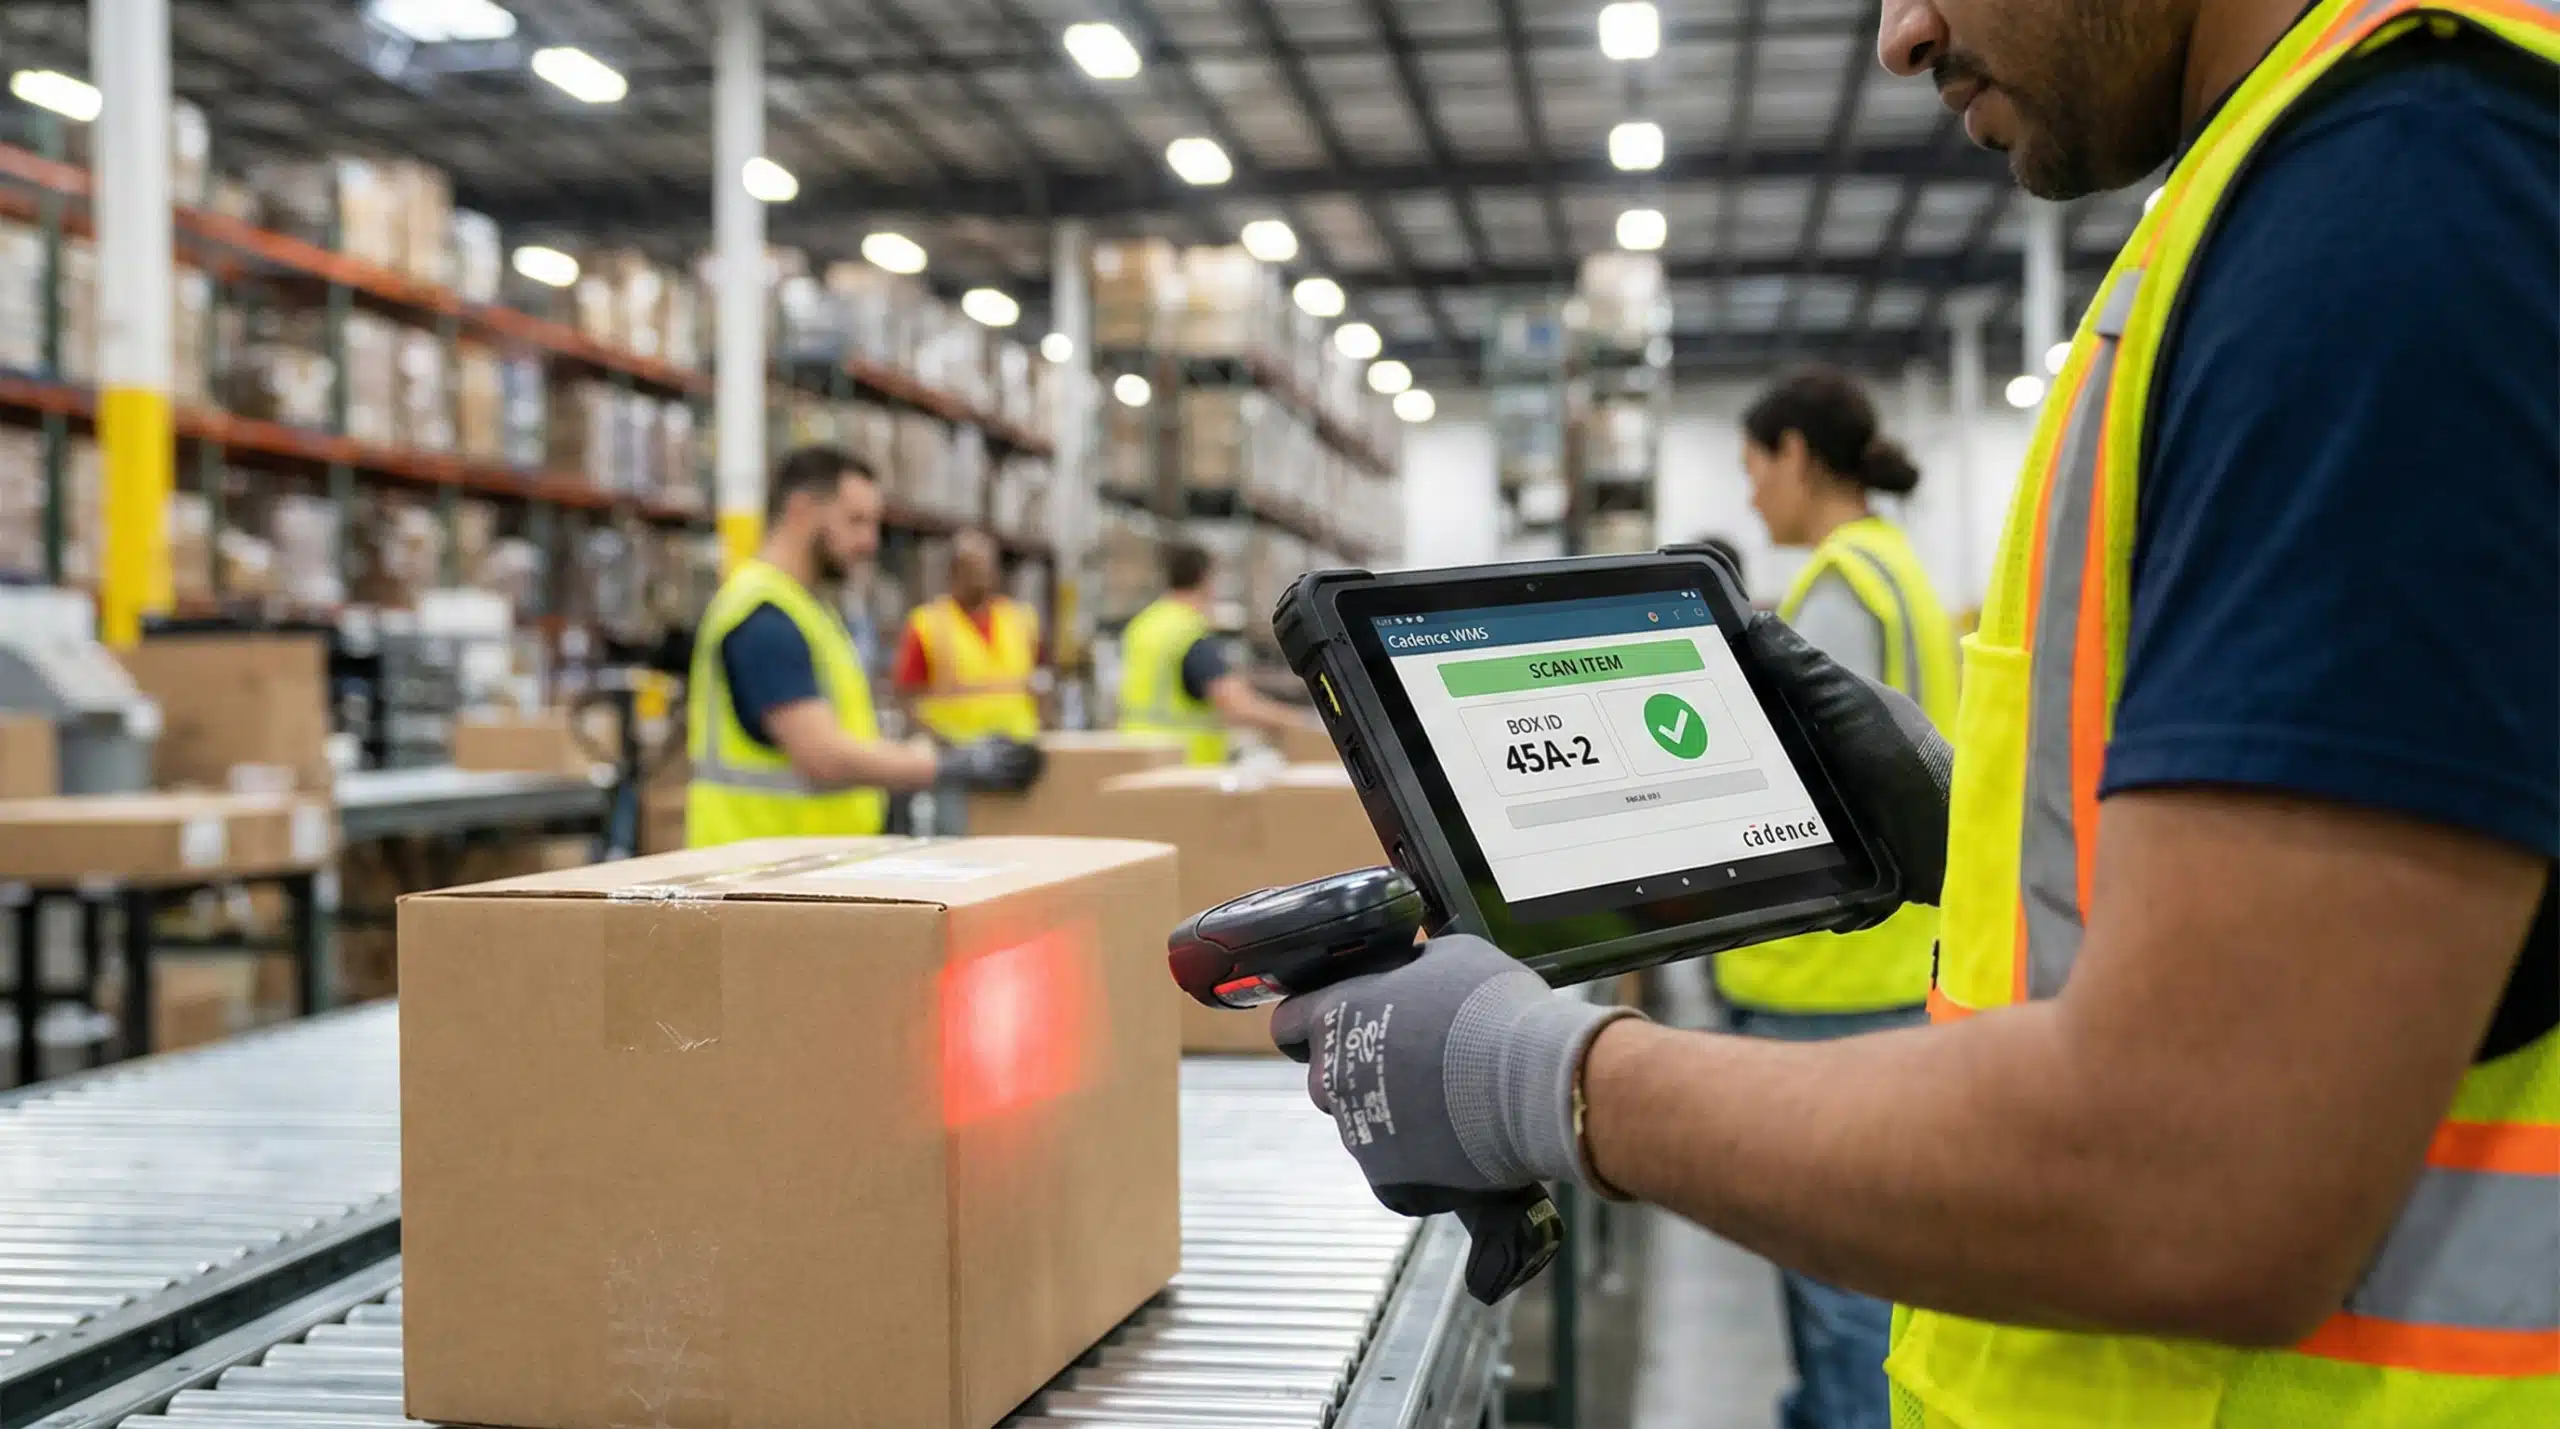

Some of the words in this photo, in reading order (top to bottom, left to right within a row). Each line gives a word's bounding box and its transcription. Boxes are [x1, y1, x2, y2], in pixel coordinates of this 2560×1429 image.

[1388, 629, 1450, 649] Cadence
[1451, 626, 1489, 643] WMS
[1529, 659, 1578, 680] SCAN
[1580, 654, 1623, 675] ITEM
[1506, 716, 1544, 735] BOX
[1544, 713, 1563, 731] ID
[1505, 735, 1600, 775] 45A-2
